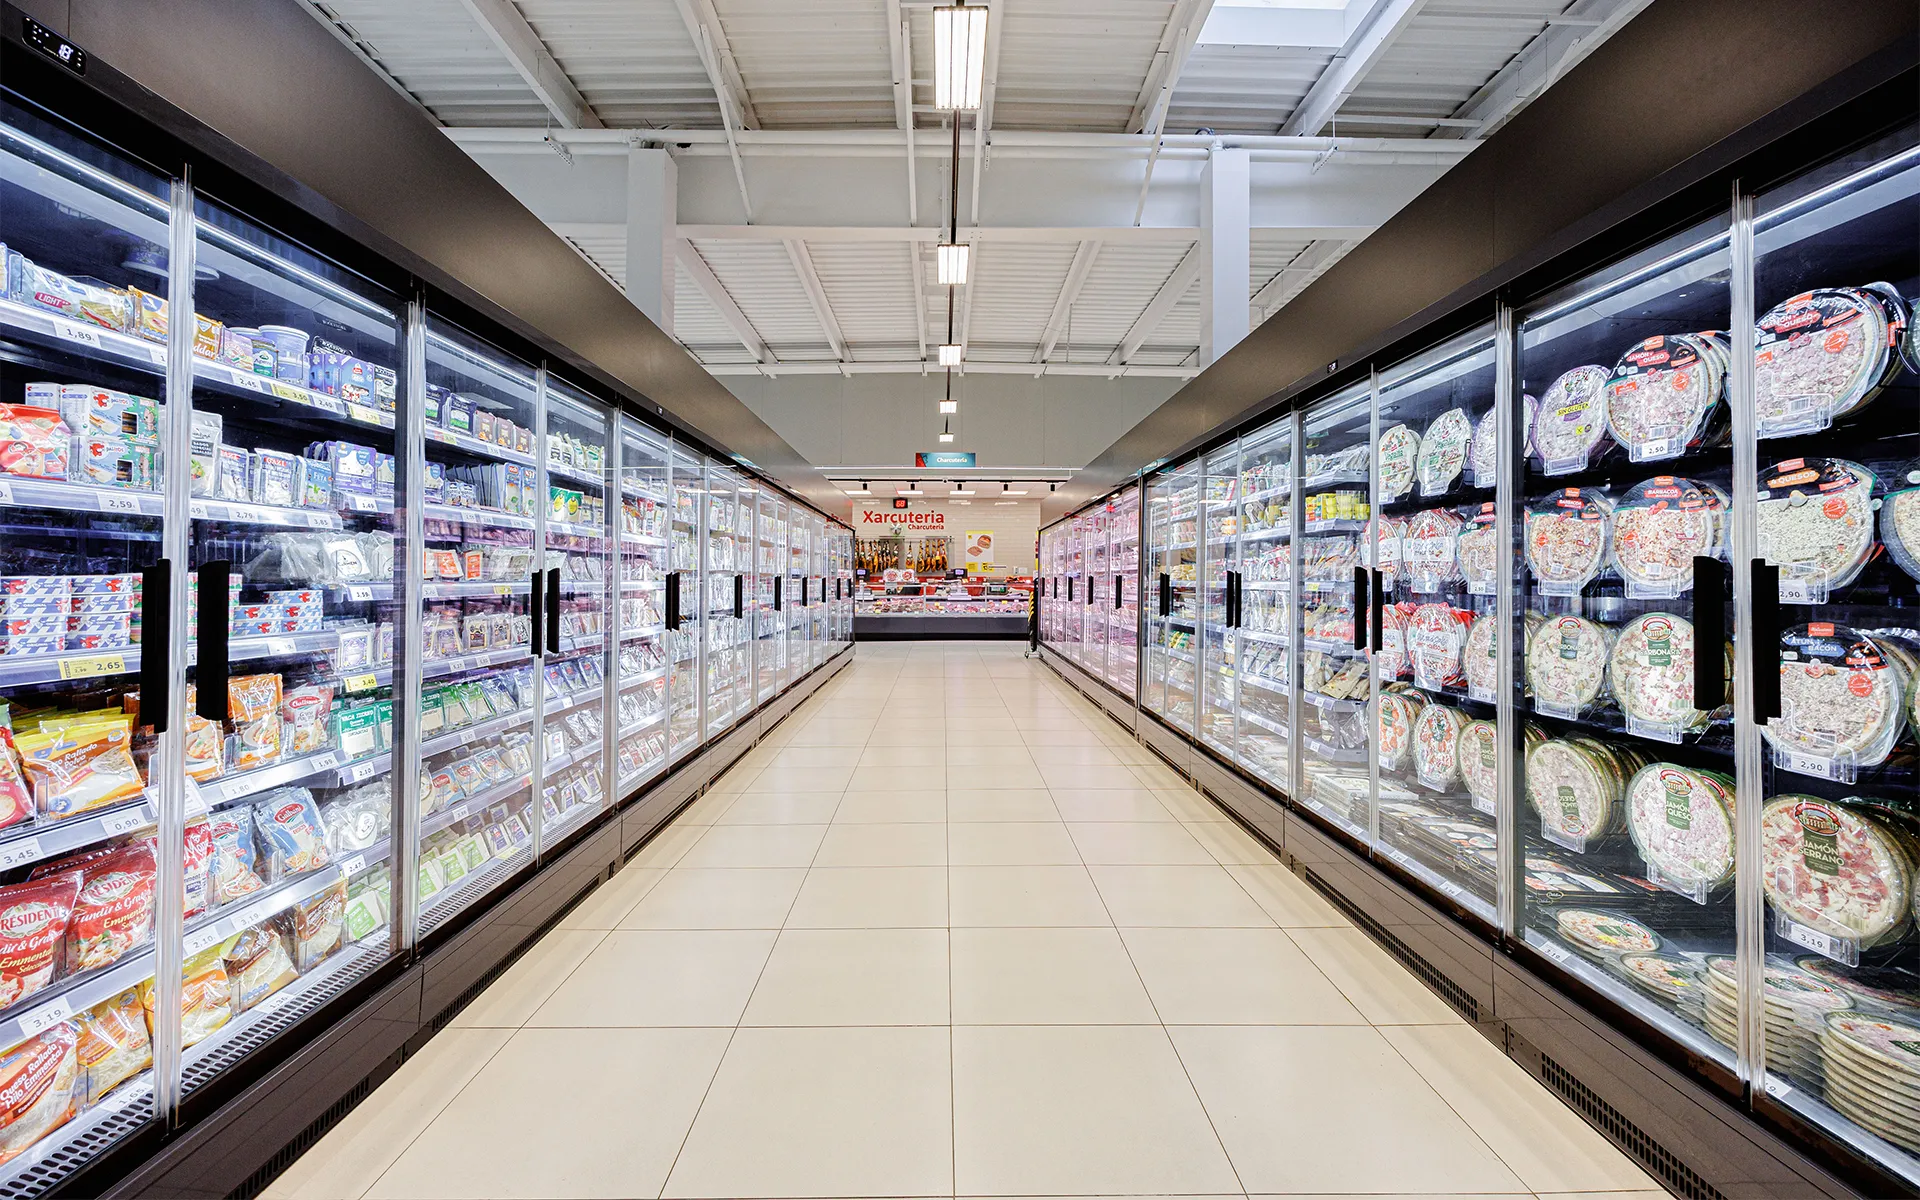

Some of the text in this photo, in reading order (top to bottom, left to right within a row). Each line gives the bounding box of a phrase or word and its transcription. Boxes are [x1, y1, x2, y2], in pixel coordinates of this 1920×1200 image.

[37, 293, 62, 308] LIGHT
[1778, 470, 1816, 485] QUESOS
[863, 510, 945, 524] Xarcuteria
[96, 661, 121, 671] 2,65
[65, 744, 98, 761] Rallado
[64, 755, 86, 769] Polvo
[1800, 760, 1823, 771] 2,90
[1667, 808, 1693, 821] QUESO
[1804, 839, 1839, 856] JAMÓN
[3, 849, 35, 864] 3,45
[1798, 848, 1844, 866] SERRANO
[1, 907, 58, 931] RÉSIDENT
[74, 906, 114, 925] Fundir
[1800, 934, 1824, 948] 3,19
[33, 1009, 62, 1029] 3,19
[0, 1043, 57, 1101] Queso Rallado
[24, 1045, 63, 1090] Emmental
